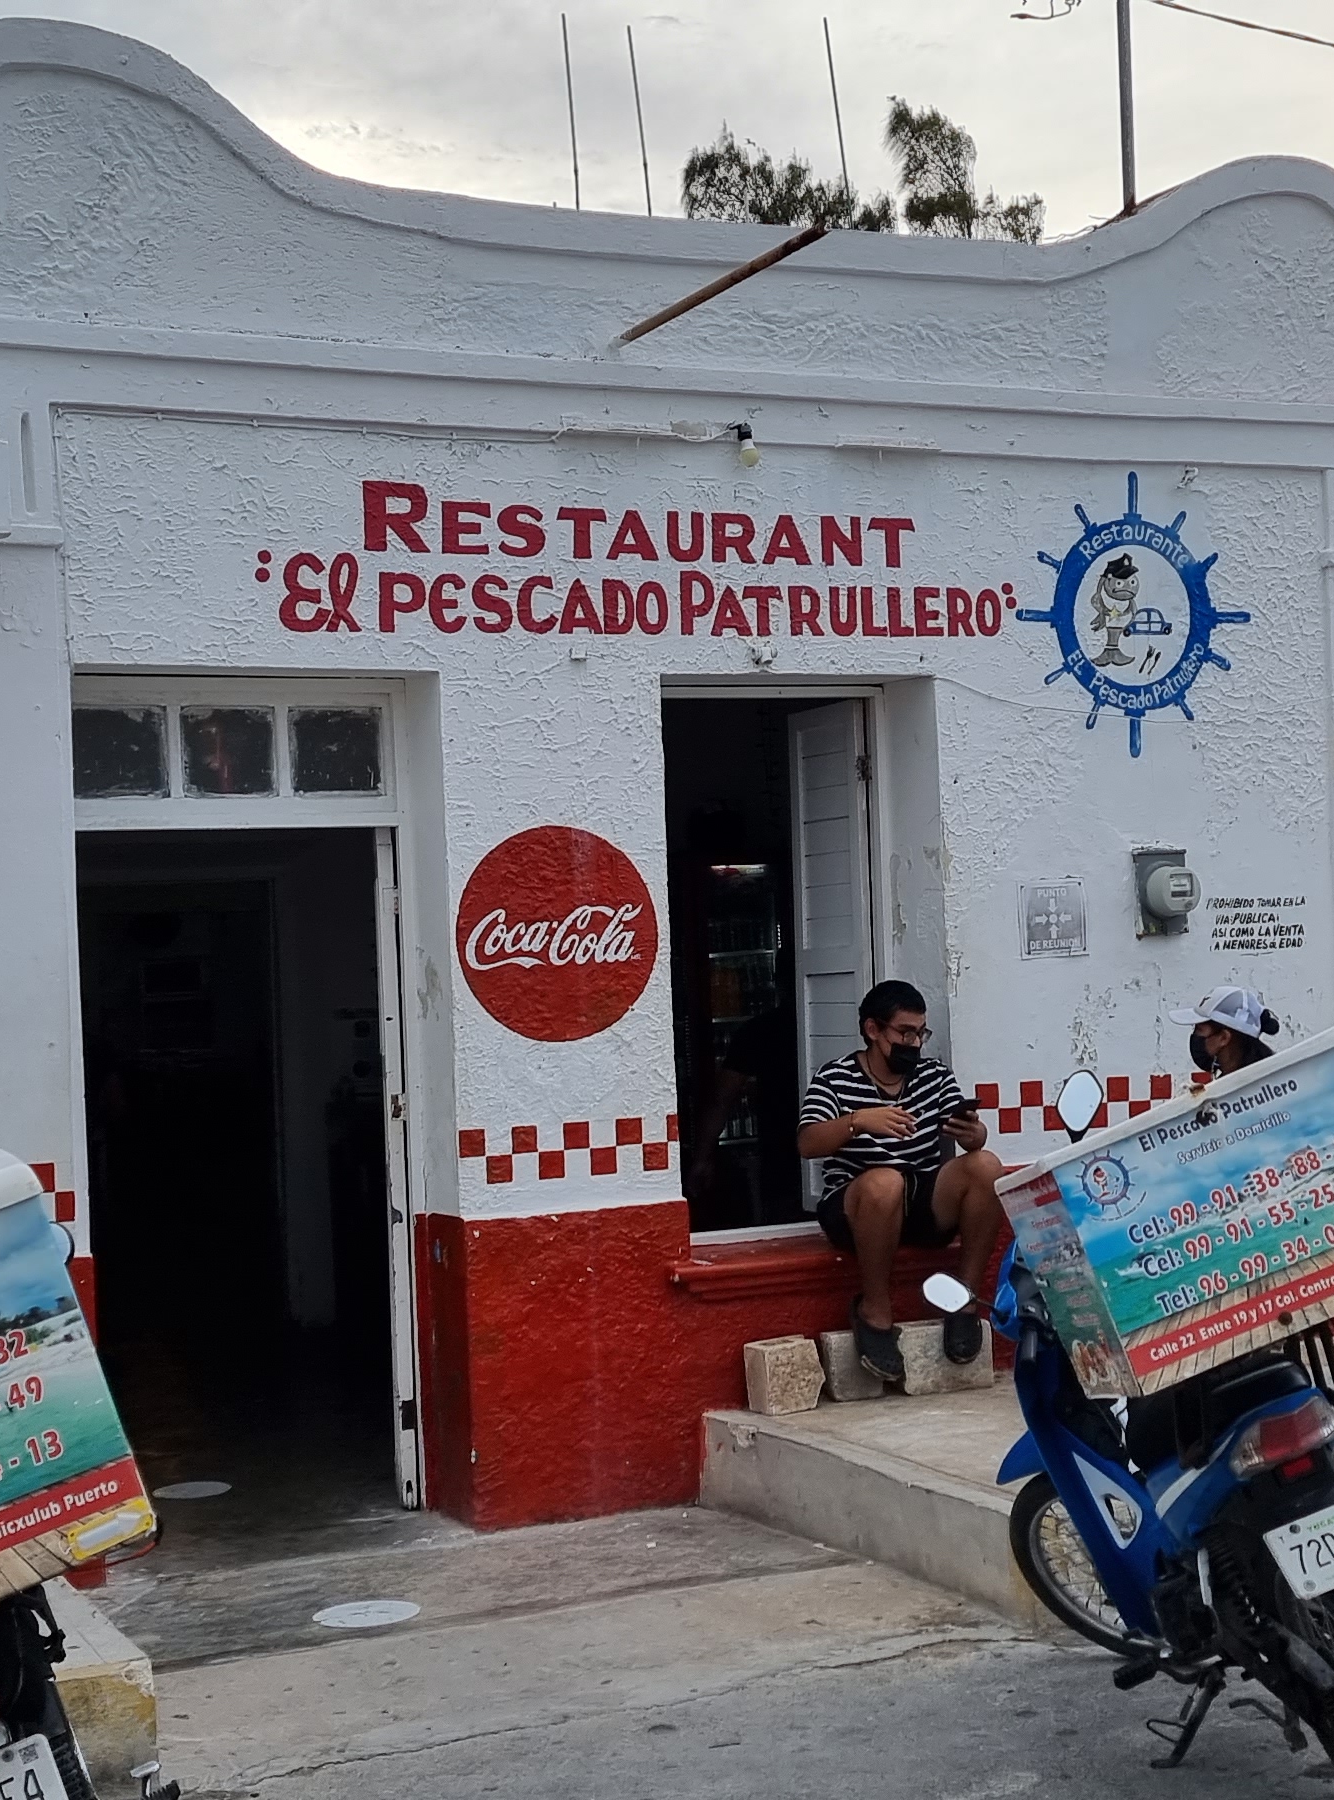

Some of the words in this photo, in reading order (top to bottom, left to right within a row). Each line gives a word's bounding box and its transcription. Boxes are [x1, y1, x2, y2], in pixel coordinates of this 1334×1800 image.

[361, 479, 915, 567] RESTAURANT
[1079, 524, 1193, 568] Restaurante
[378, 570, 666, 636] PESCADO
[1090, 675, 1152, 710] Pescado
[1037, 887, 1066, 898] PUNTO
[1206, 897, 1255, 909] PROHIBIDO
[1283, 897, 1294, 907] EN
[1295, 896, 1306, 906] LA
[1030, 940, 1042, 950] DE
[1212, 927, 1227, 938] ASI
[1230, 927, 1255, 938] COMO
[1258, 926, 1272, 937] LA
[1273, 924, 1304, 937] VENTA
[1223, 939, 1268, 950] MENORES
[1279, 938, 1303, 949] EDAD
[1138, 1134, 1155, 1153] El
[1220, 1079, 1298, 1119] Patrullero
[1177, 1139, 1223, 1165] Servicio
[1234, 1111, 1291, 1142] Domicilio
[1128, 1217, 1168, 1244] Cel:
[1170, 1201, 1197, 1227] 99
[1210, 1184, 1238, 1210] 91
[1252, 1168, 1280, 1194] 38
[1293, 1151, 1321, 1176] 88
[1142, 1249, 1184, 1278] Cel:
[1184, 1234, 1212, 1260] 99
[1225, 1218, 1253, 1243] 91
[1268, 1201, 1296, 1226] 55
[1150, 1341, 1179, 1361] Calle
[1180, 1335, 1196, 1349] 22
[1199, 1319, 1231, 1341] Entre
[1233, 1310, 1247, 1325] 19
[1259, 1300, 1273, 1314] 17
[7, 1376, 45, 1412] 49
[27, 1429, 64, 1466] 13
[63, 1480, 119, 1511] Puerto
